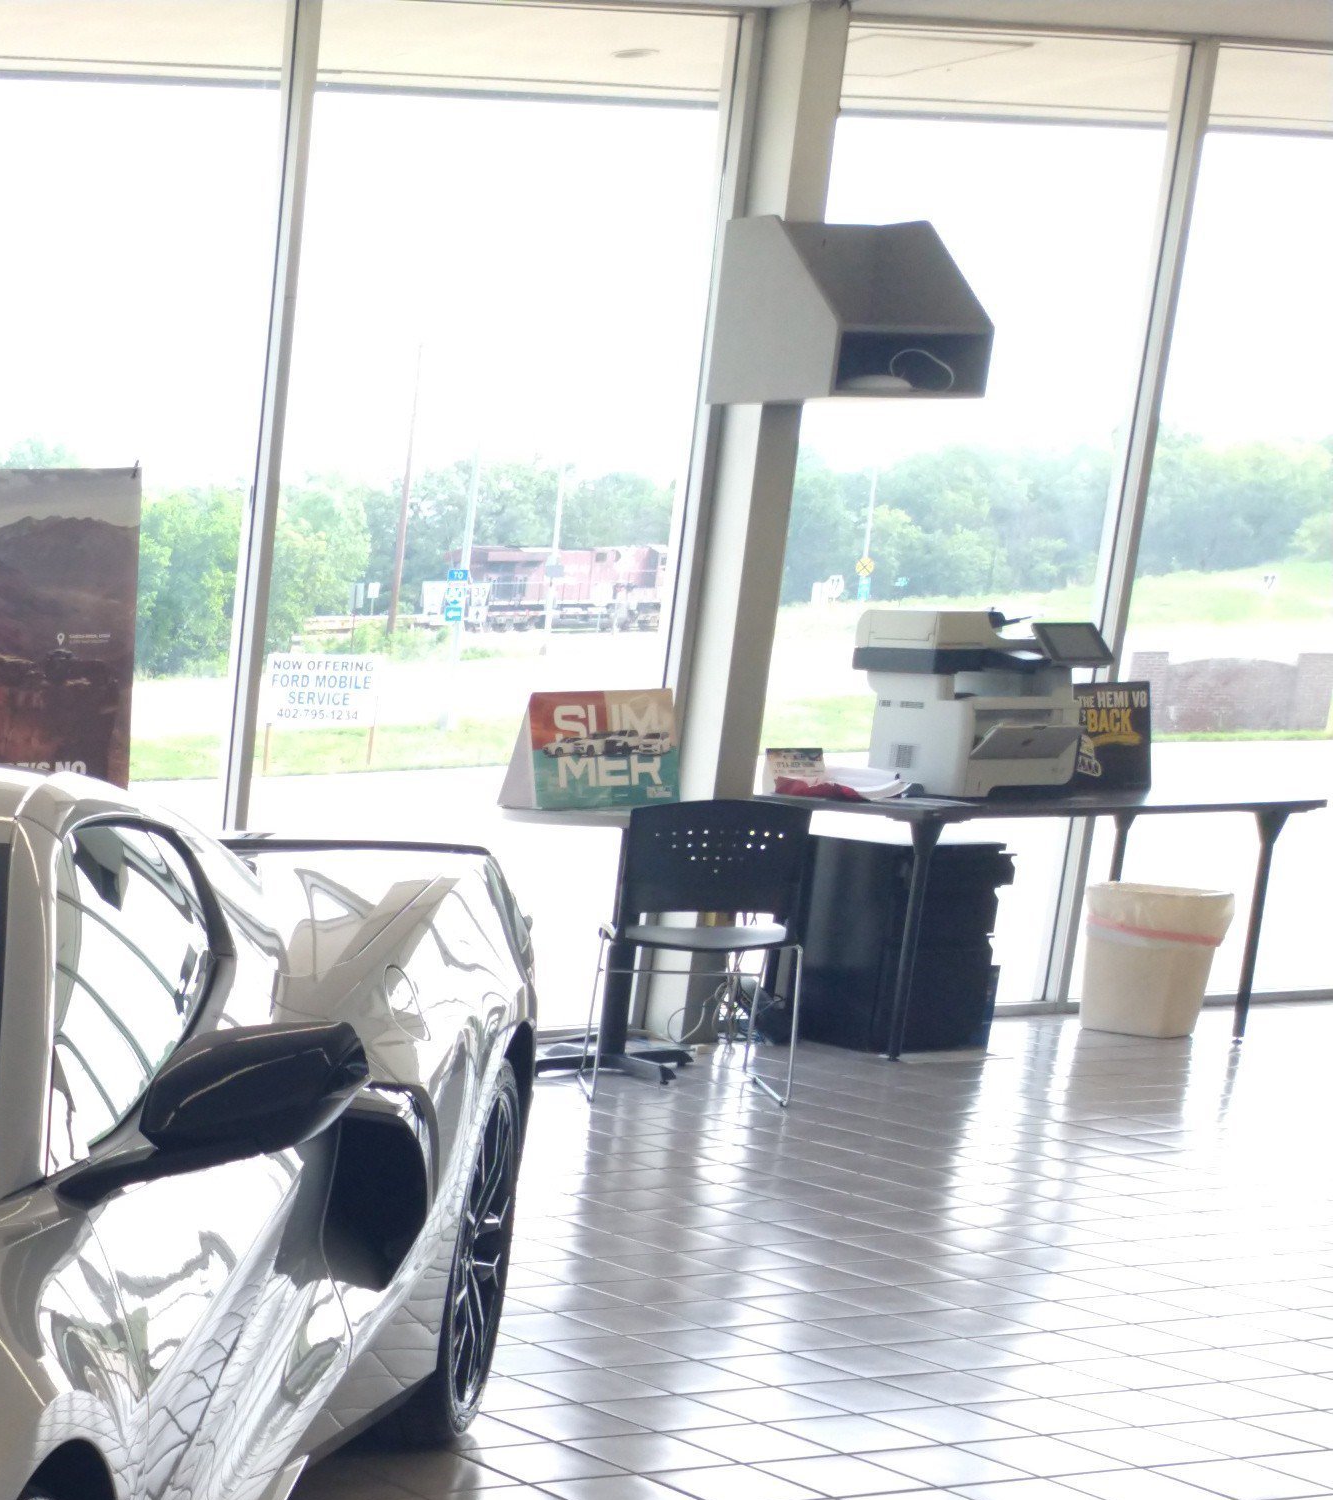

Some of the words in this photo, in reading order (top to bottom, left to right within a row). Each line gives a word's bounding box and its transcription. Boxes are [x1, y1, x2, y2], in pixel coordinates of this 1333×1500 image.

[454, 571, 464, 579] TO
[273, 660, 302, 671] NOW
[307, 660, 374, 672] OFFERING
[271, 673, 310, 688] FORD
[315, 675, 372, 690] MOBILE
[288, 691, 350, 706] SERVICE
[1077, 695, 1095, 708] THE
[1096, 690, 1130, 709] HEMI
[1131, 690, 1149, 709] V8
[1086, 708, 1133, 733] BACK
[557, 754, 663, 788] MER
